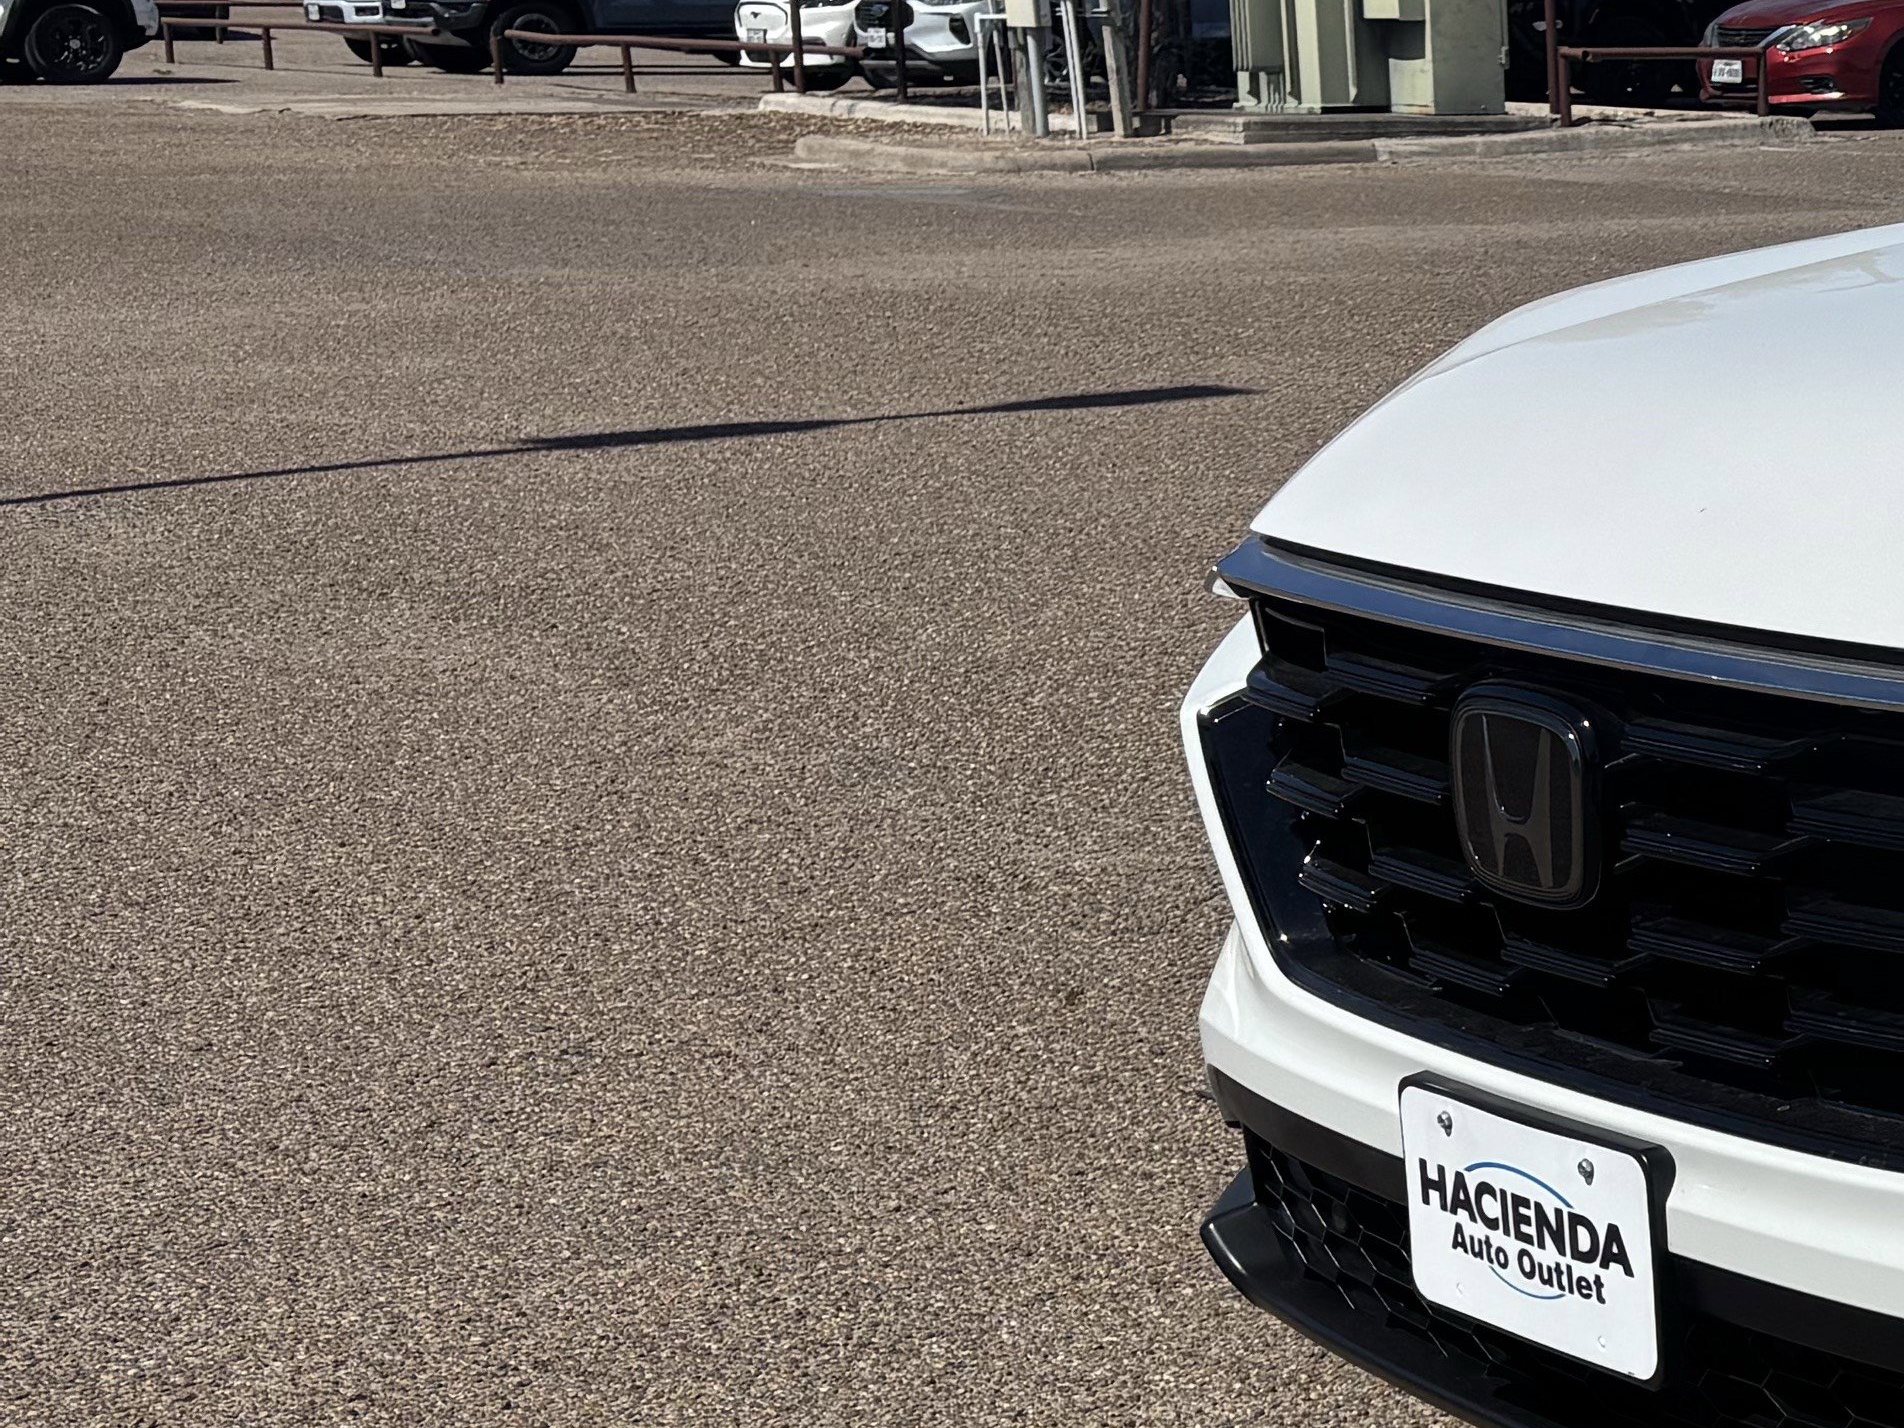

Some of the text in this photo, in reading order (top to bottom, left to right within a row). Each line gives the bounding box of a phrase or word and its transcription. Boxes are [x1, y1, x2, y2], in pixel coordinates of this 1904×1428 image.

[1418, 1156, 1635, 1279] HACIENDA
[1451, 1221, 1607, 1305] Auto Outlet
